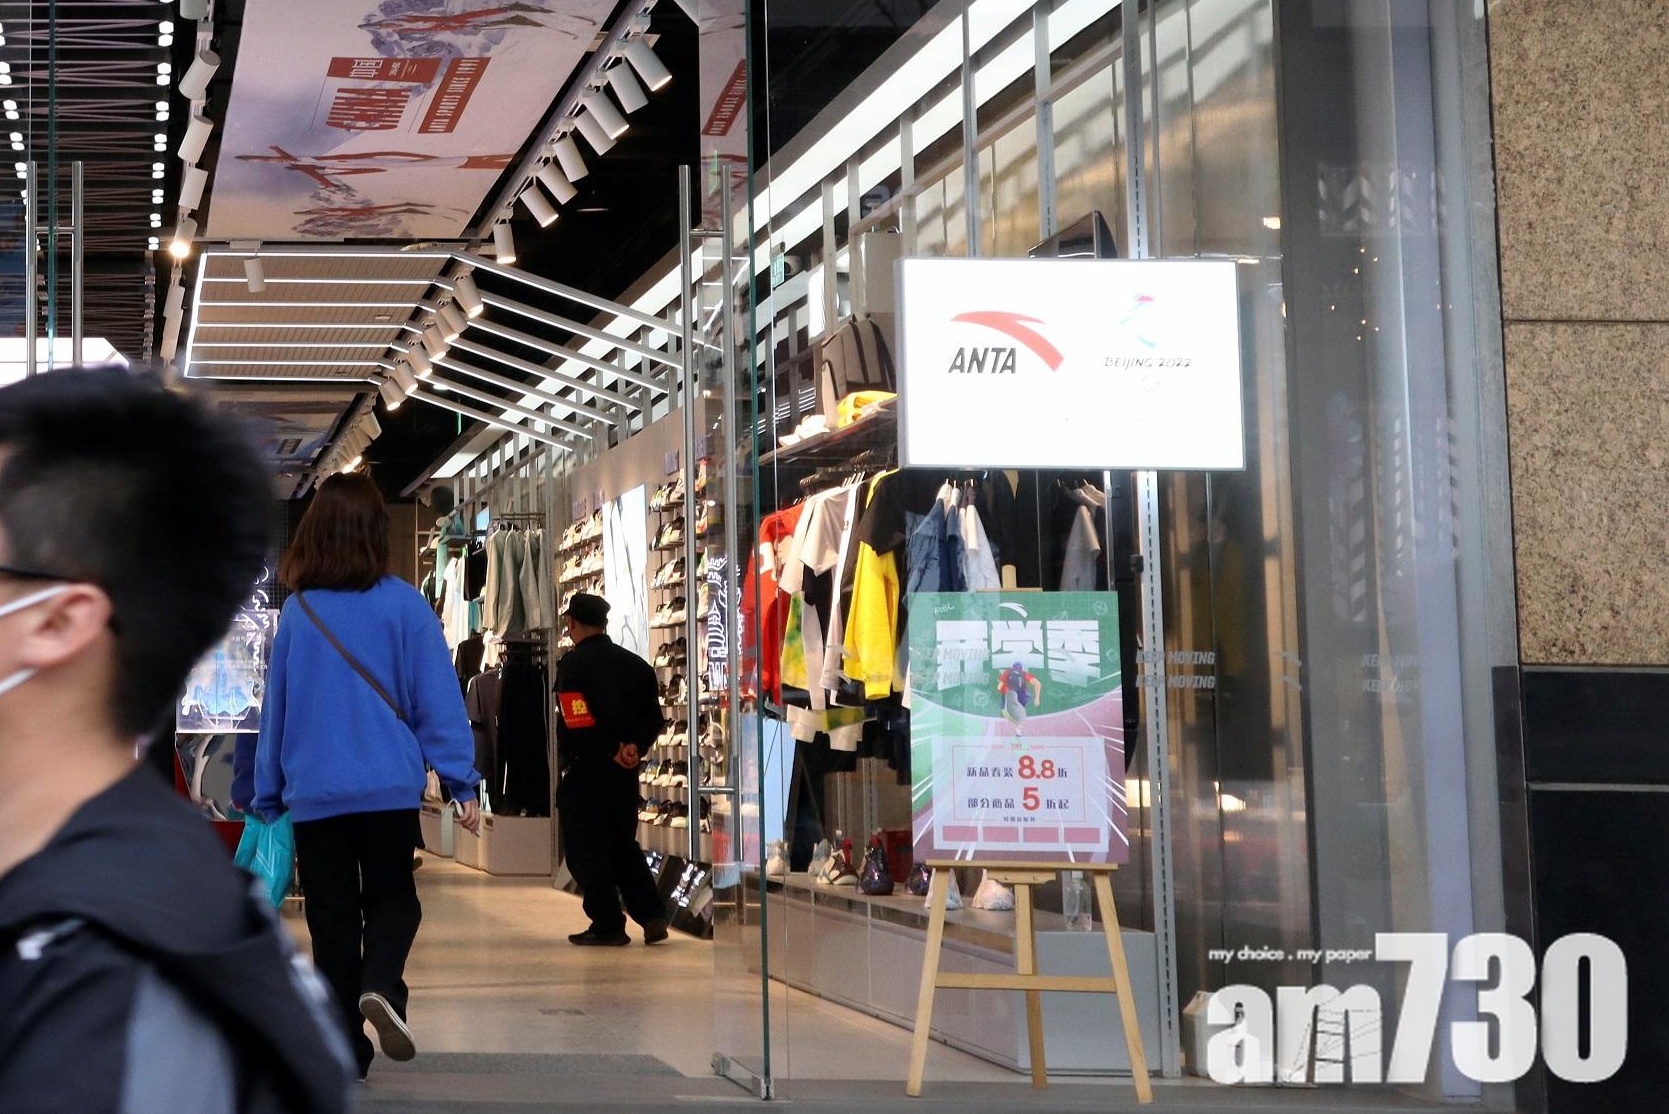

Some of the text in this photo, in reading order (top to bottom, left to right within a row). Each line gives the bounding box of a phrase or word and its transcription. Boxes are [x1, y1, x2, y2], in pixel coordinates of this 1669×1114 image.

[948, 347, 1017, 374] ANTA
[1103, 357, 1193, 371] BEIJING 2022
[936, 620, 1101, 691] 开学季
[1168, 651, 1216, 665] MOVING
[1168, 675, 1216, 689] MOVING
